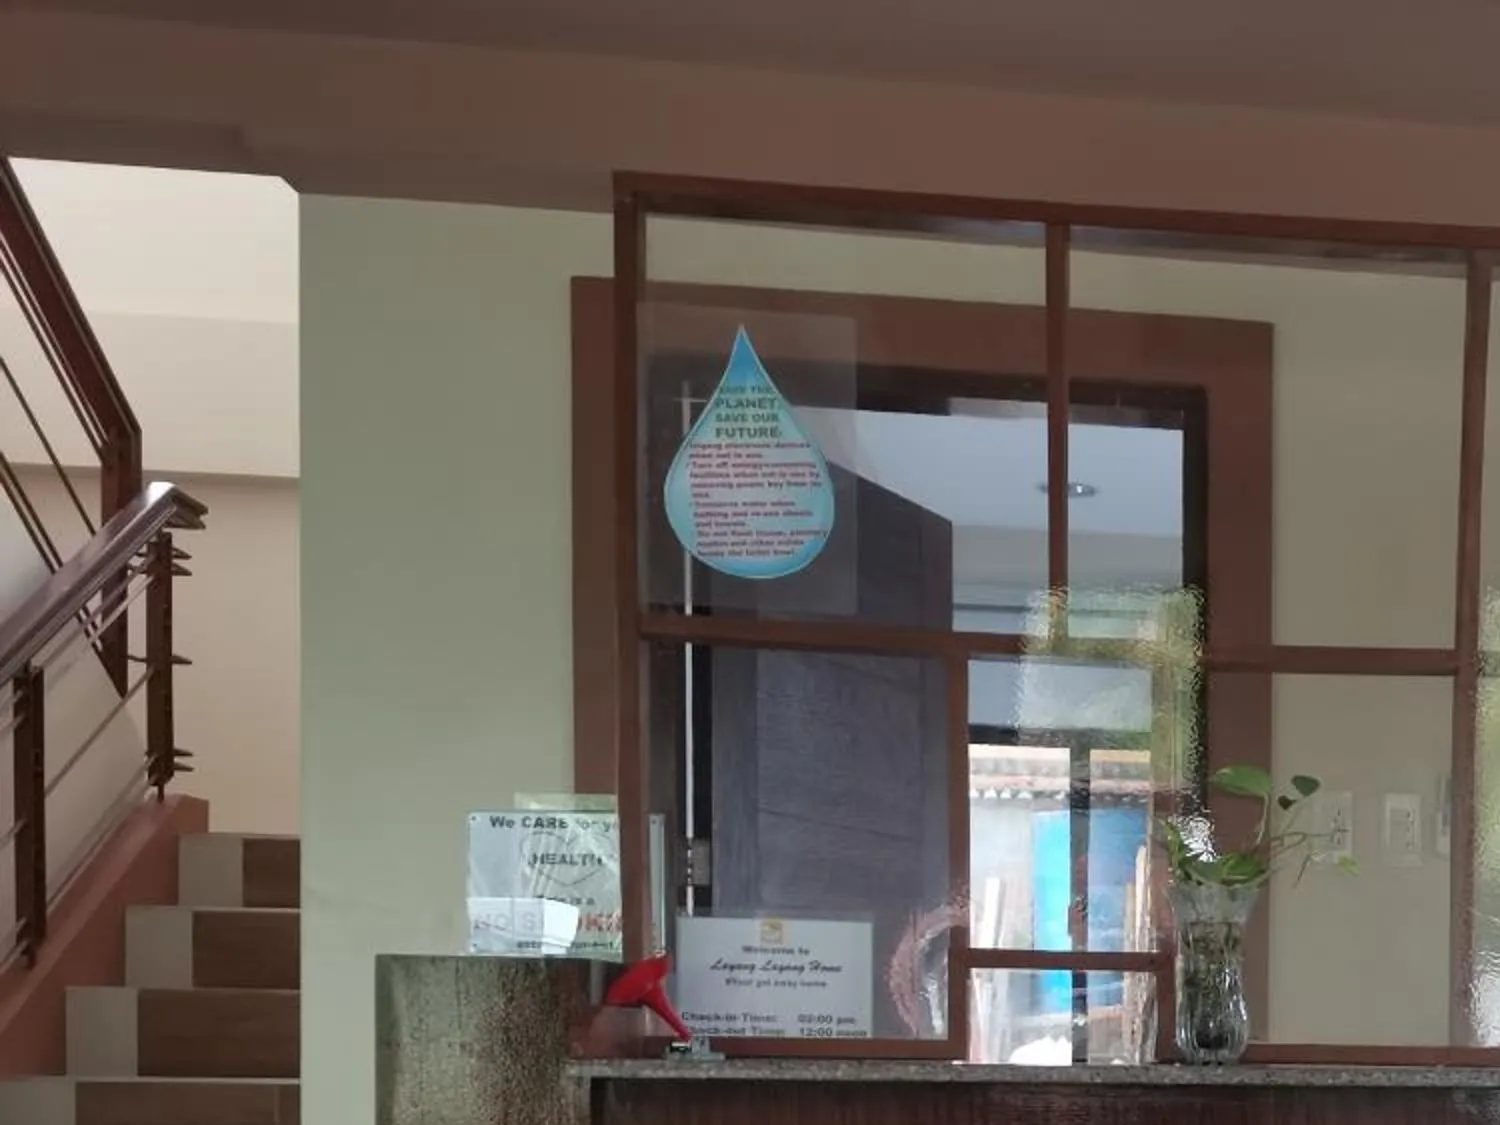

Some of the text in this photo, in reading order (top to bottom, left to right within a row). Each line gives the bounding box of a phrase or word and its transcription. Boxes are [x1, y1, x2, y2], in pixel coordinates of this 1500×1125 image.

[715, 413, 779, 423] SAVE OUR
[489, 815, 516, 829] We
[521, 815, 569, 829] CARE
[799, 1027, 833, 1036] 12:00
